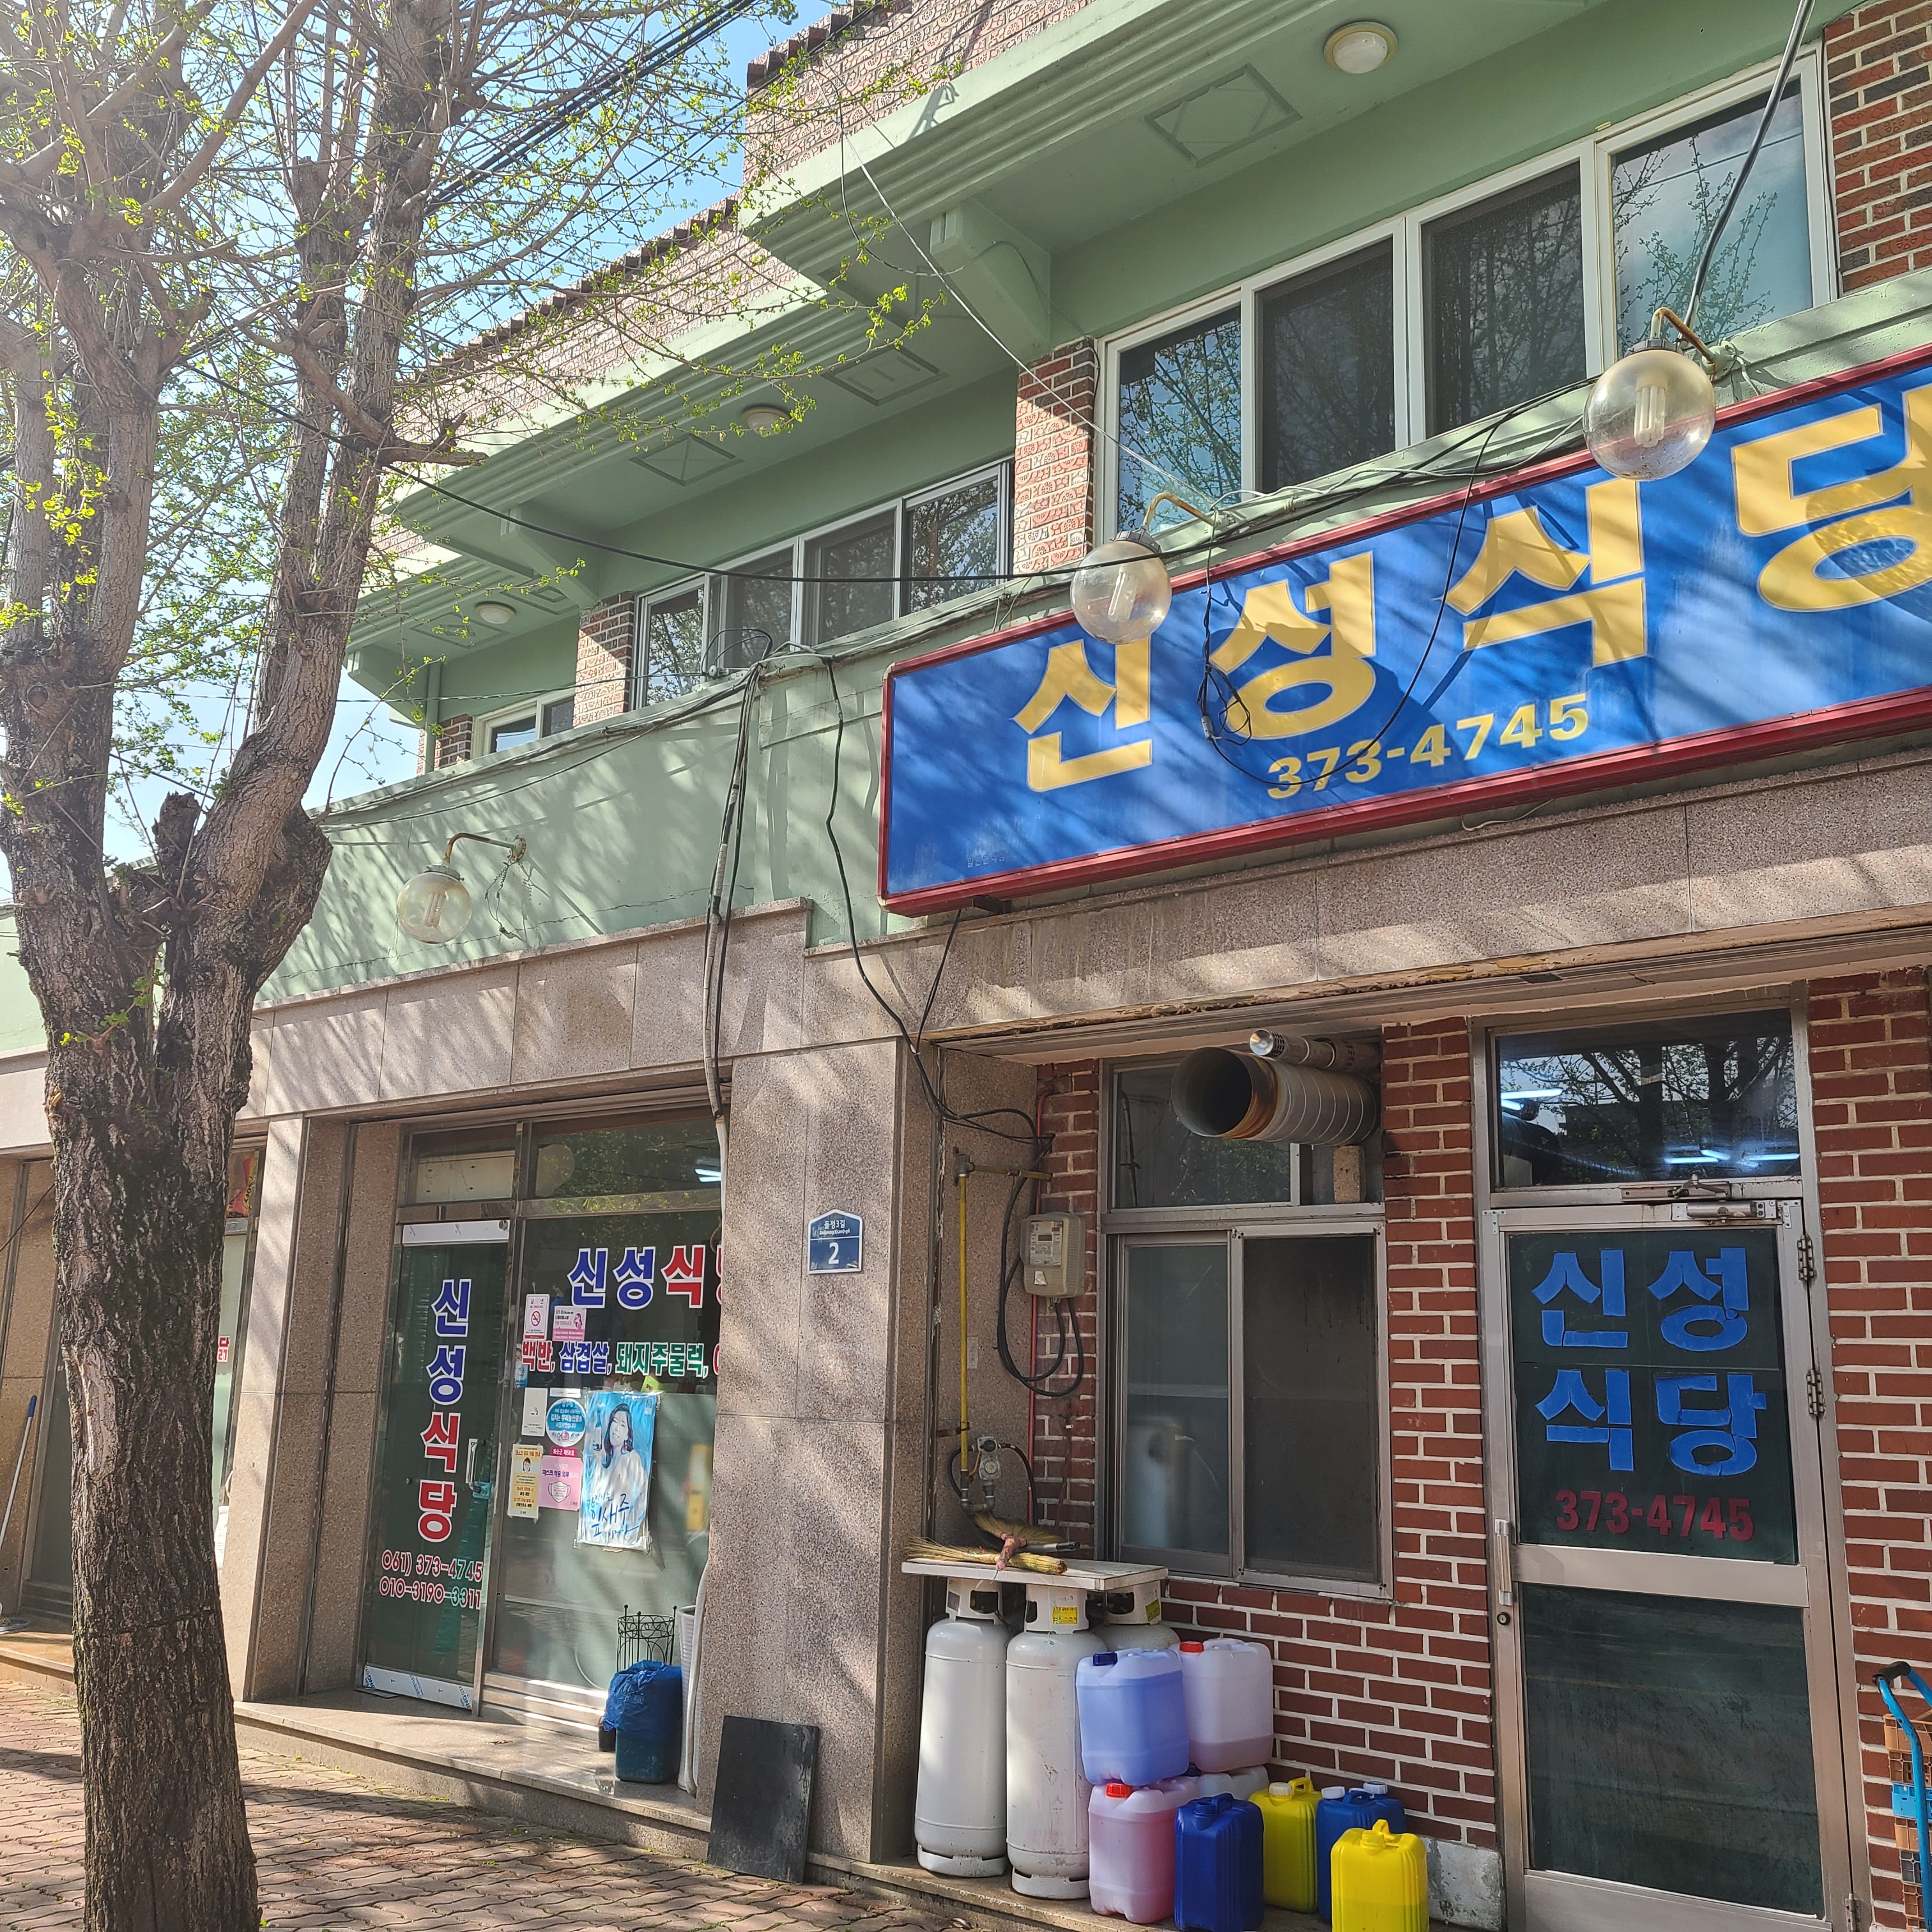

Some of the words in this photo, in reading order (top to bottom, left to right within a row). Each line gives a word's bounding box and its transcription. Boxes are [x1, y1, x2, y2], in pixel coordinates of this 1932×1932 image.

[1268, 693, 1589, 799] 373-4745
[567, 1245, 722, 1310] 신성식
[828, 1242, 839, 1264] 2
[1531, 1248, 1749, 1351] 신성
[522, 1340, 555, 1373] 백반,
[559, 1341, 612, 1375] 삼겹살,
[615, 1342, 708, 1379] 돼지주물럭,
[418, 1278, 471, 1543] 신성식당
[1535, 1369, 1767, 1476] 식당
[1555, 1489, 1754, 1541] 373-4745
[379, 1576, 482, 1610] 010-3190-3311
[382, 1549, 412, 1576] 061)
[416, 1554, 484, 1583] 373-4745
